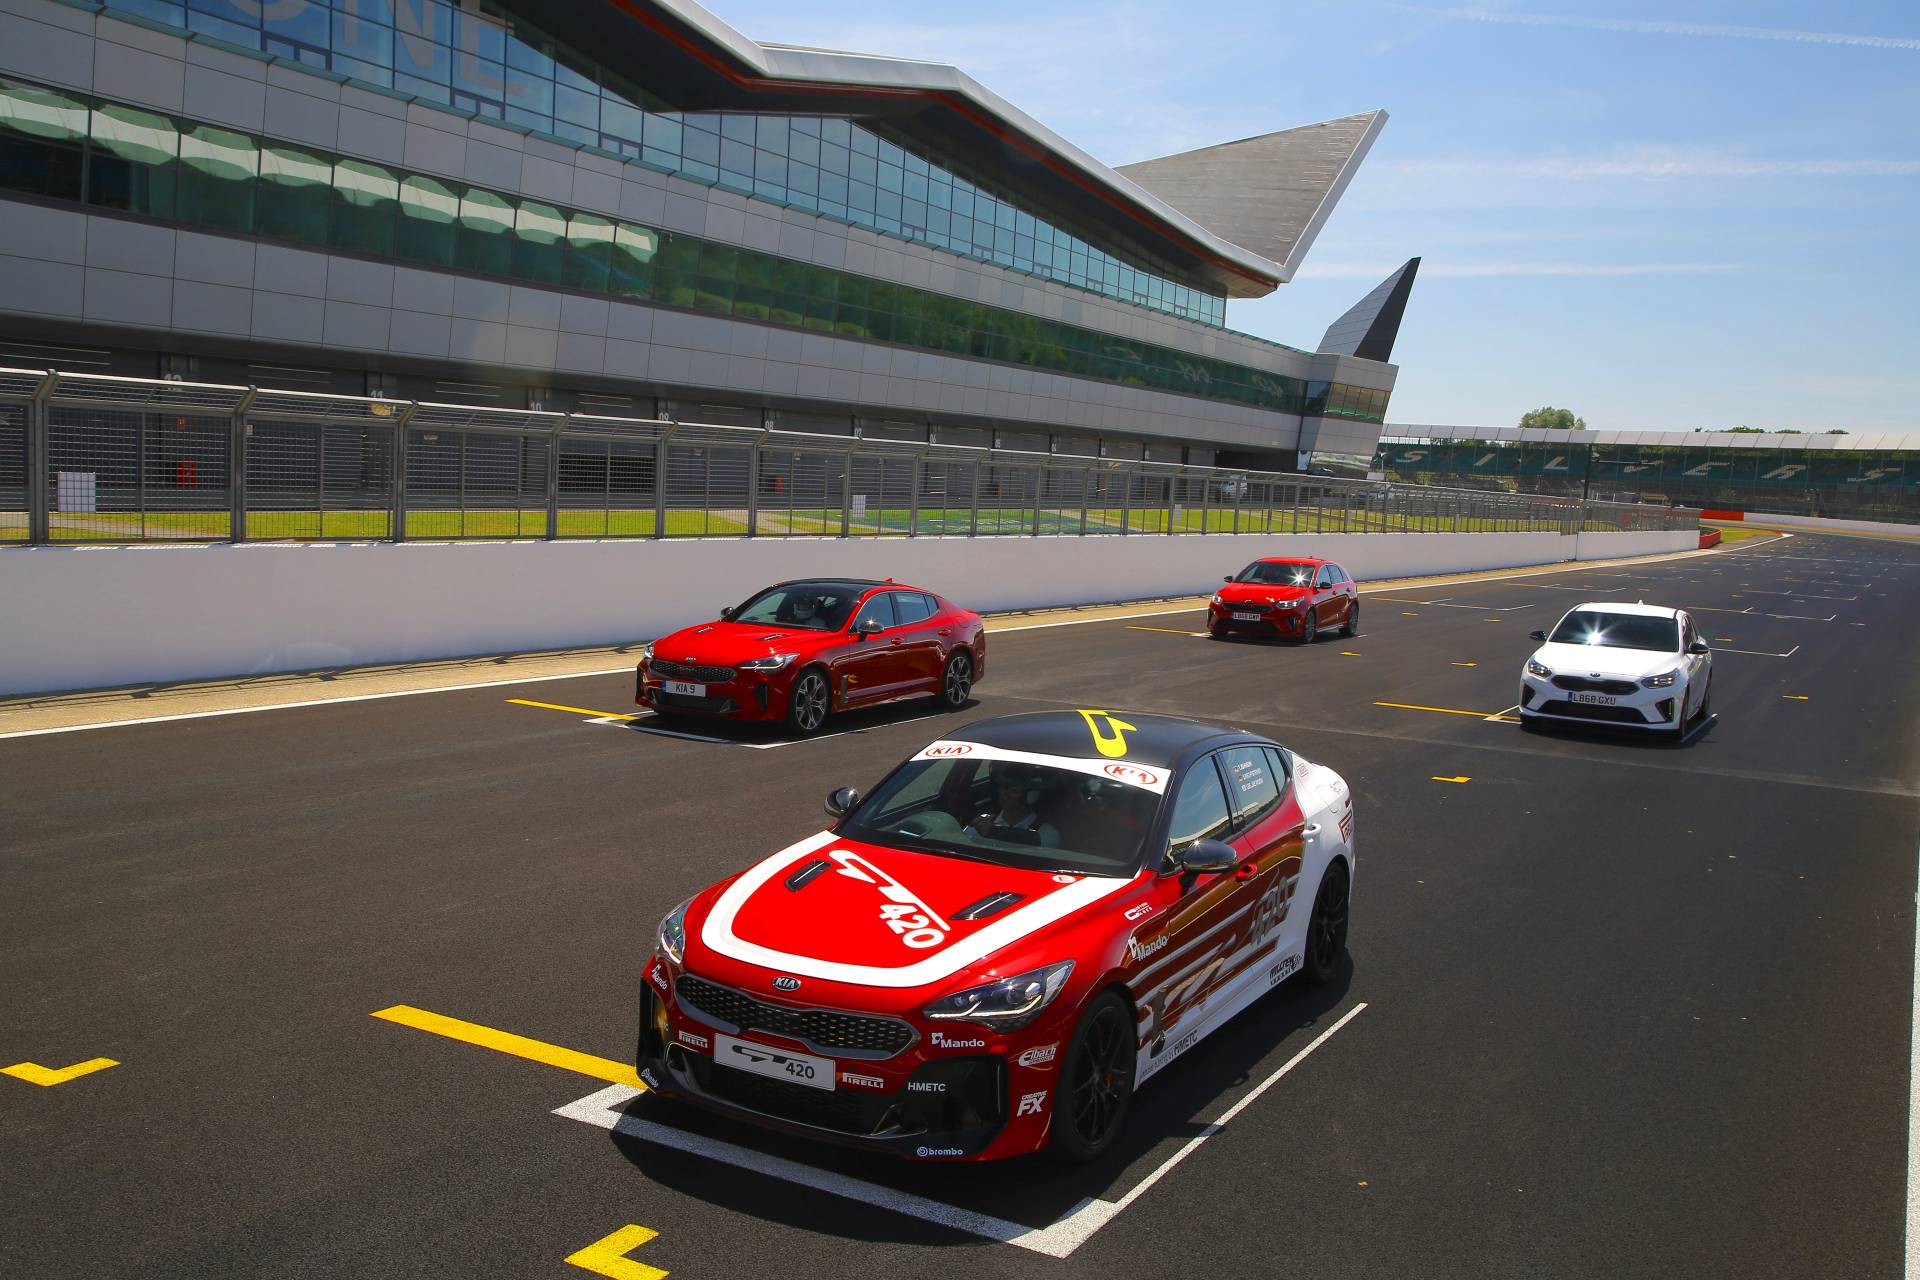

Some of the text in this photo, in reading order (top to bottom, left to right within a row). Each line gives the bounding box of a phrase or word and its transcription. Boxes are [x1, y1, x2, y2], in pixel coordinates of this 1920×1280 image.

[675, 683, 696, 694] KIA 9
[1573, 693, 1616, 706] LB68 GXU
[931, 746, 964, 756] KIA
[1111, 765, 1149, 785] KIA
[879, 904, 945, 949] 420
[1137, 934, 1169, 961] Mando
[775, 977, 797, 990] KIA
[678, 1029, 709, 1049] PIRELLI
[940, 1038, 986, 1049] Mando
[1174, 1030, 1199, 1057] HMETC
[1018, 1045, 1057, 1067] Eibach
[785, 1062, 815, 1080] 420
[842, 1072, 884, 1089] PIRELLI
[907, 1082, 946, 1092] HMETC
[1016, 1096, 1046, 1117] FX
